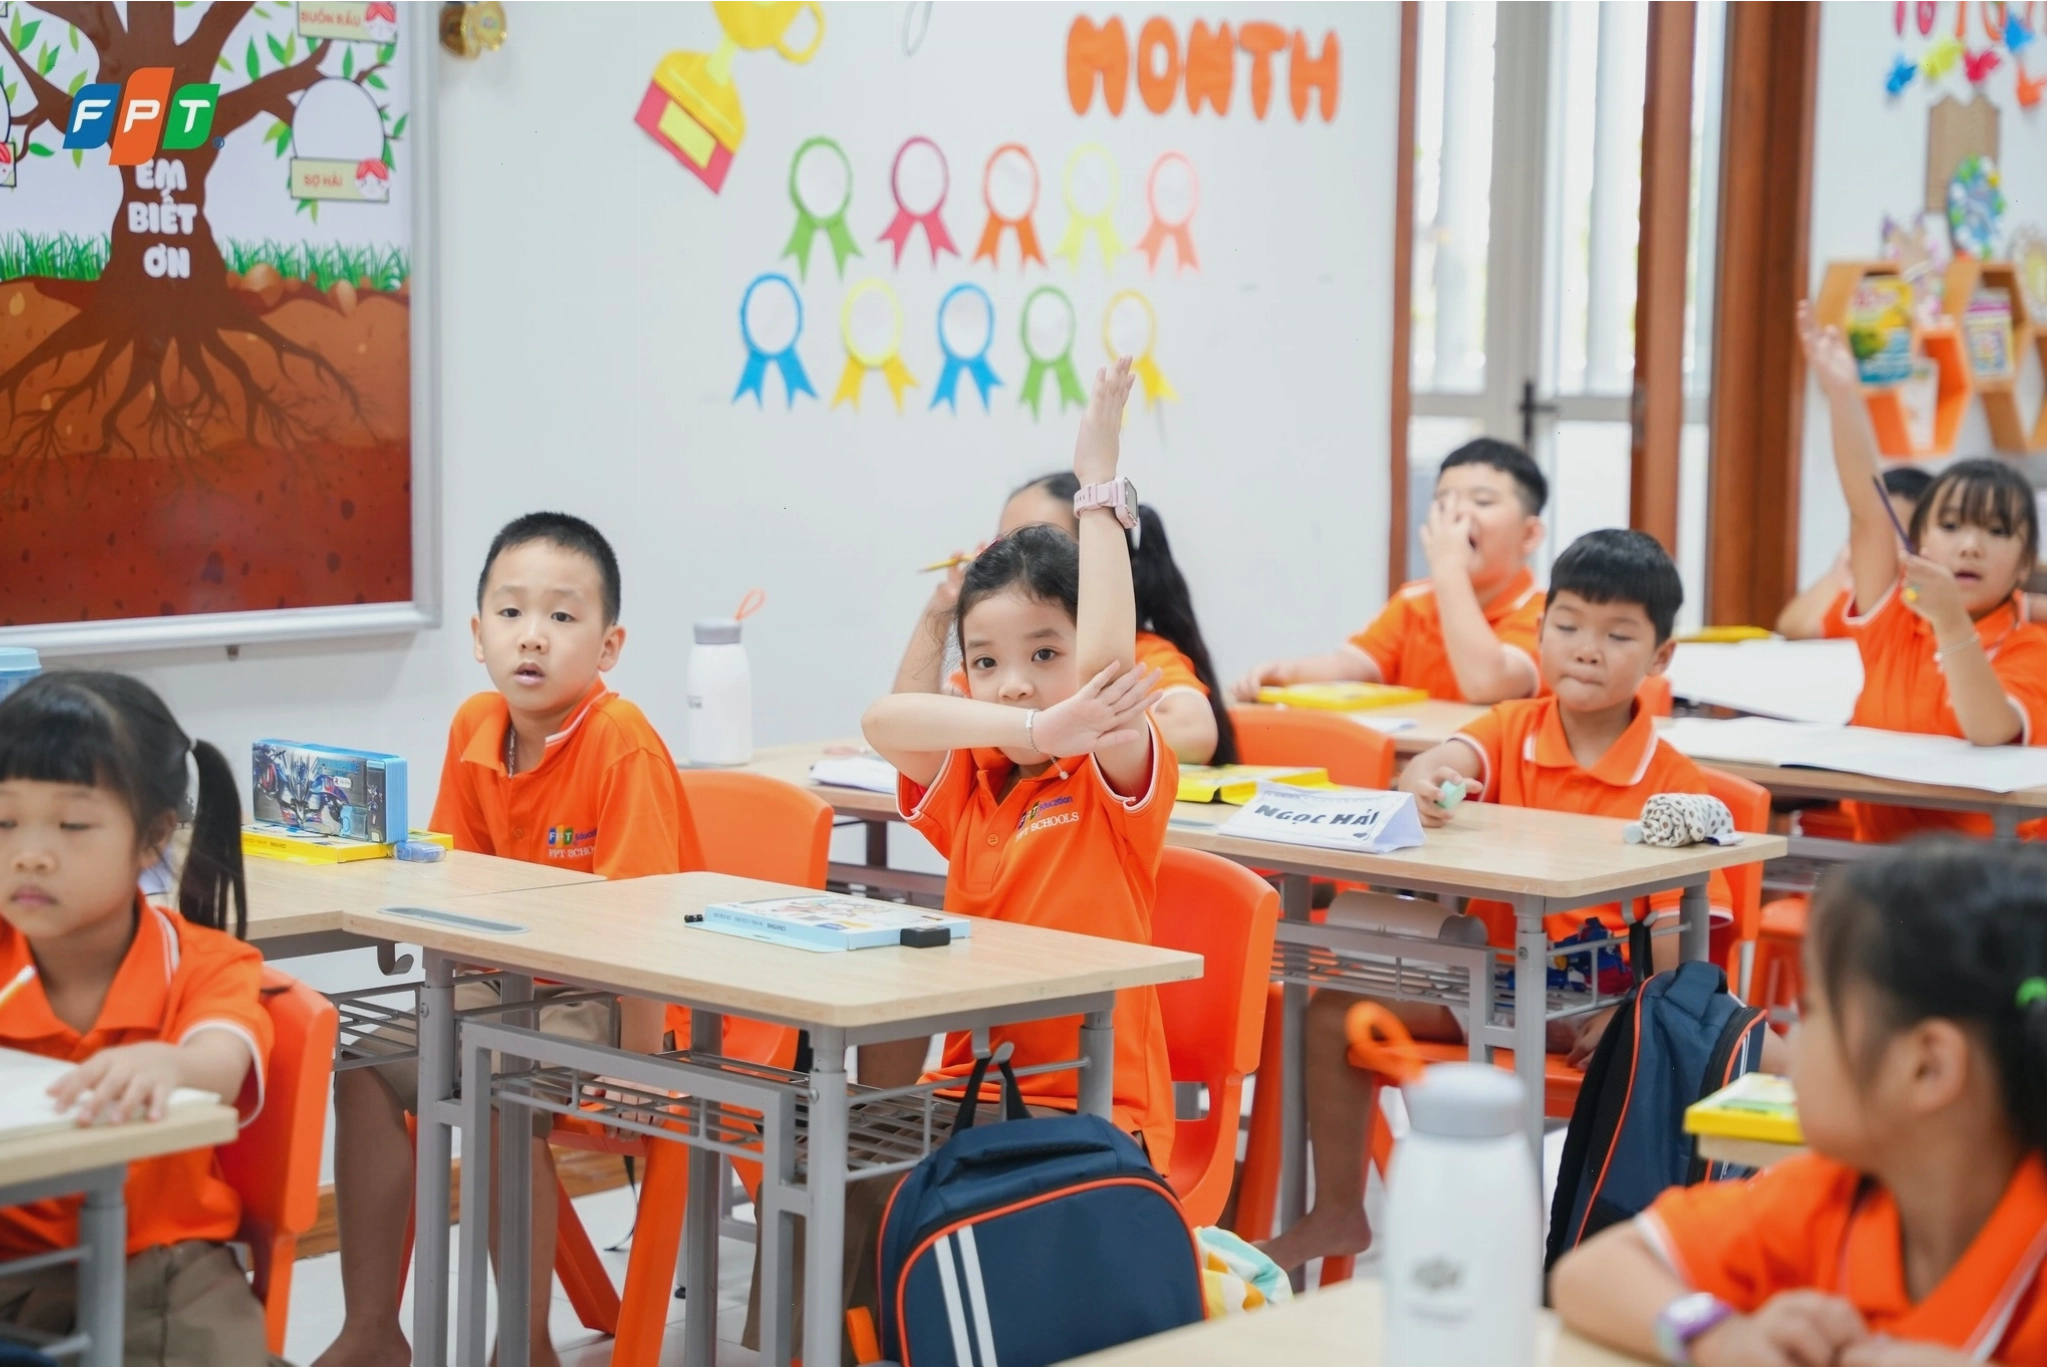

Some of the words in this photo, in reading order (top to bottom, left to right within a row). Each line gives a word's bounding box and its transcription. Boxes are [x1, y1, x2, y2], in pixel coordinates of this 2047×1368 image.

[1067, 14, 1339, 122] MONTH
[135, 158, 187, 191] EM
[128, 187, 197, 235] BIẾT
[143, 243, 190, 279] ƠN
[1031, 812, 1079, 831] SCHOOLS
[1254, 804, 1327, 824] NGỌC
[1329, 809, 1379, 825] HẢI
